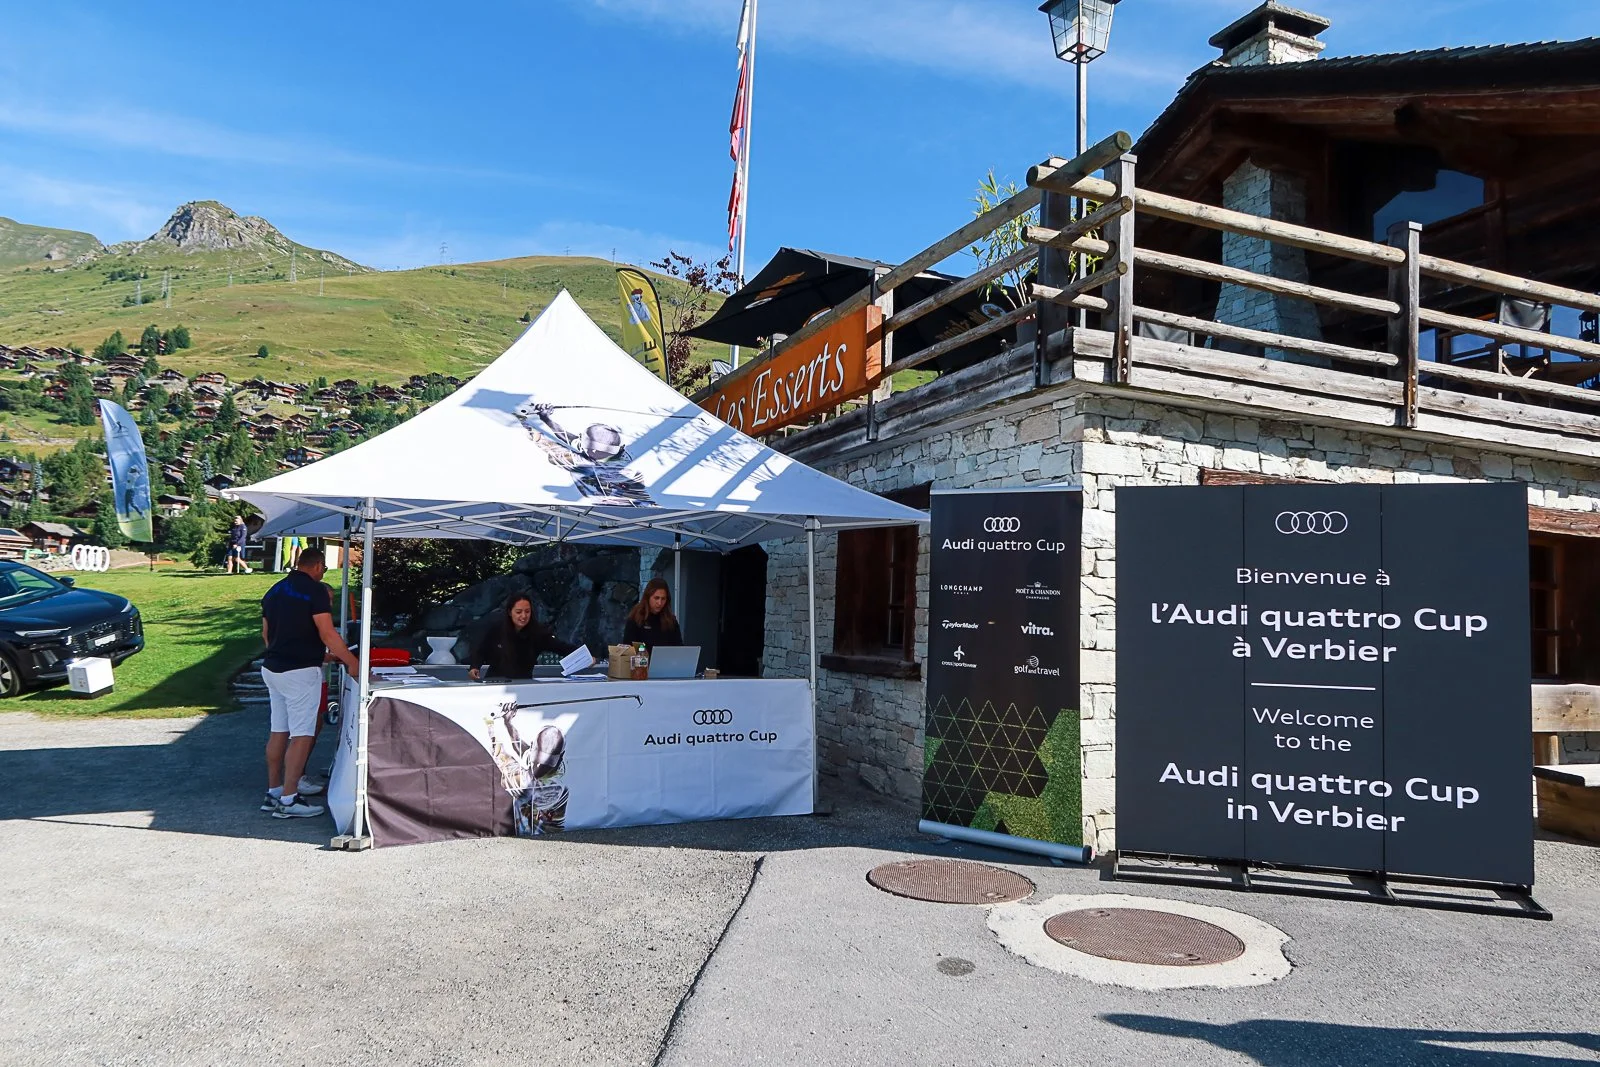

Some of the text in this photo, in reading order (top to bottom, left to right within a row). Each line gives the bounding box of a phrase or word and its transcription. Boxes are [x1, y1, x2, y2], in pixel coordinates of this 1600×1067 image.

[751, 342, 847, 428] Esserts
[941, 538, 1066, 554] Audi quattro Cup
[1236, 567, 1390, 586] Bienvenue à
[940, 584, 983, 592] LONGCHAMP
[941, 619, 979, 629] TaylorMade
[1260, 608, 1402, 632] quattro
[1413, 608, 1488, 638] Cup
[1232, 635, 1397, 663] à Verbier
[1252, 707, 1374, 729] Welcome
[644, 729, 778, 747] Audi quattro Cup
[1274, 733, 1352, 751] to the
[1158, 762, 1480, 809] Audi quattro Cup
[1227, 797, 1406, 832] in Verbier
